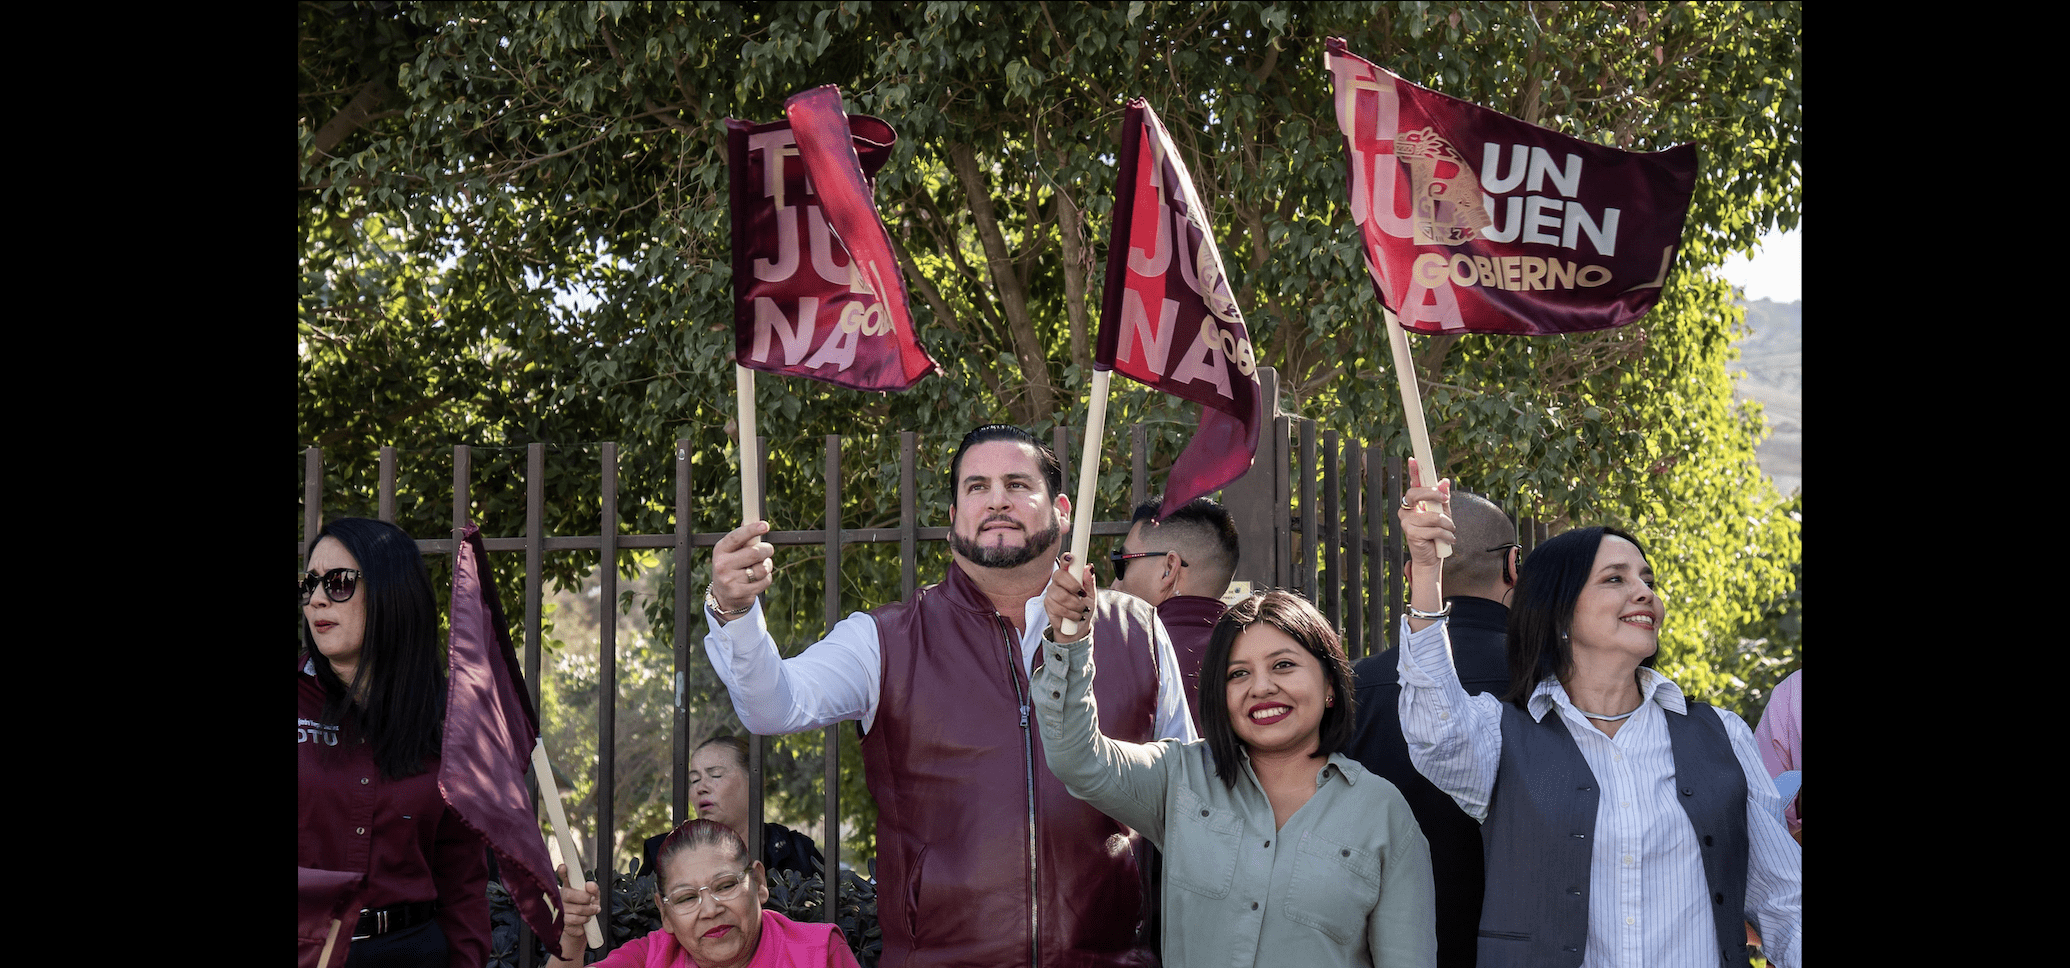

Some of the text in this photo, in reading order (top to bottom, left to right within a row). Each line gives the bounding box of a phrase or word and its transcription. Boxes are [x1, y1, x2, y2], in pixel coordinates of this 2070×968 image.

[1480, 142, 1583, 198] UN
[1412, 252, 1613, 291] GOBIERNO
[751, 297, 860, 372] NA
[1116, 287, 1234, 401] NA
